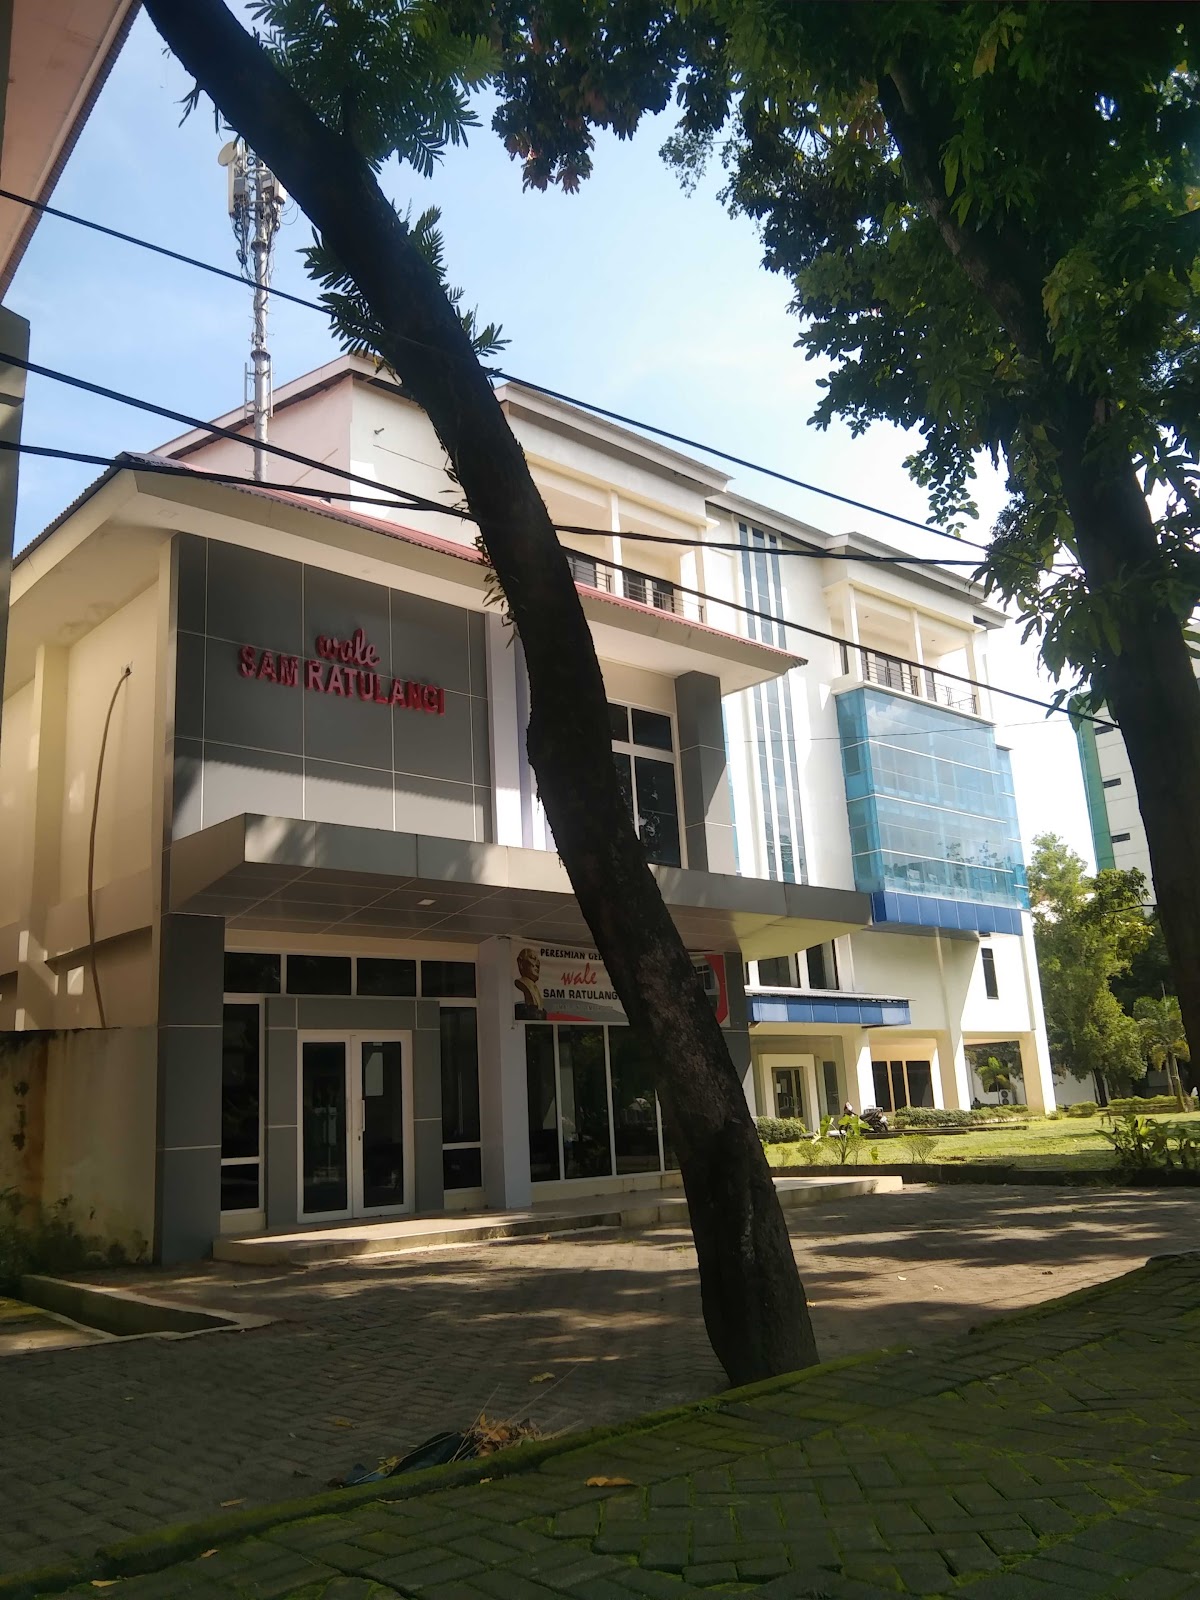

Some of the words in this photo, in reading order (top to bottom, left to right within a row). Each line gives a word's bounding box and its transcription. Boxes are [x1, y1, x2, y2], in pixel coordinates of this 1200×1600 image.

[239, 645, 298, 686] SAM
[540, 948, 585, 960] PERESMIAN
[588, 952, 604, 961] GED
[562, 962, 598, 986] wale
[543, 988, 565, 999] SAM
[569, 990, 618, 1001] RATULANG
